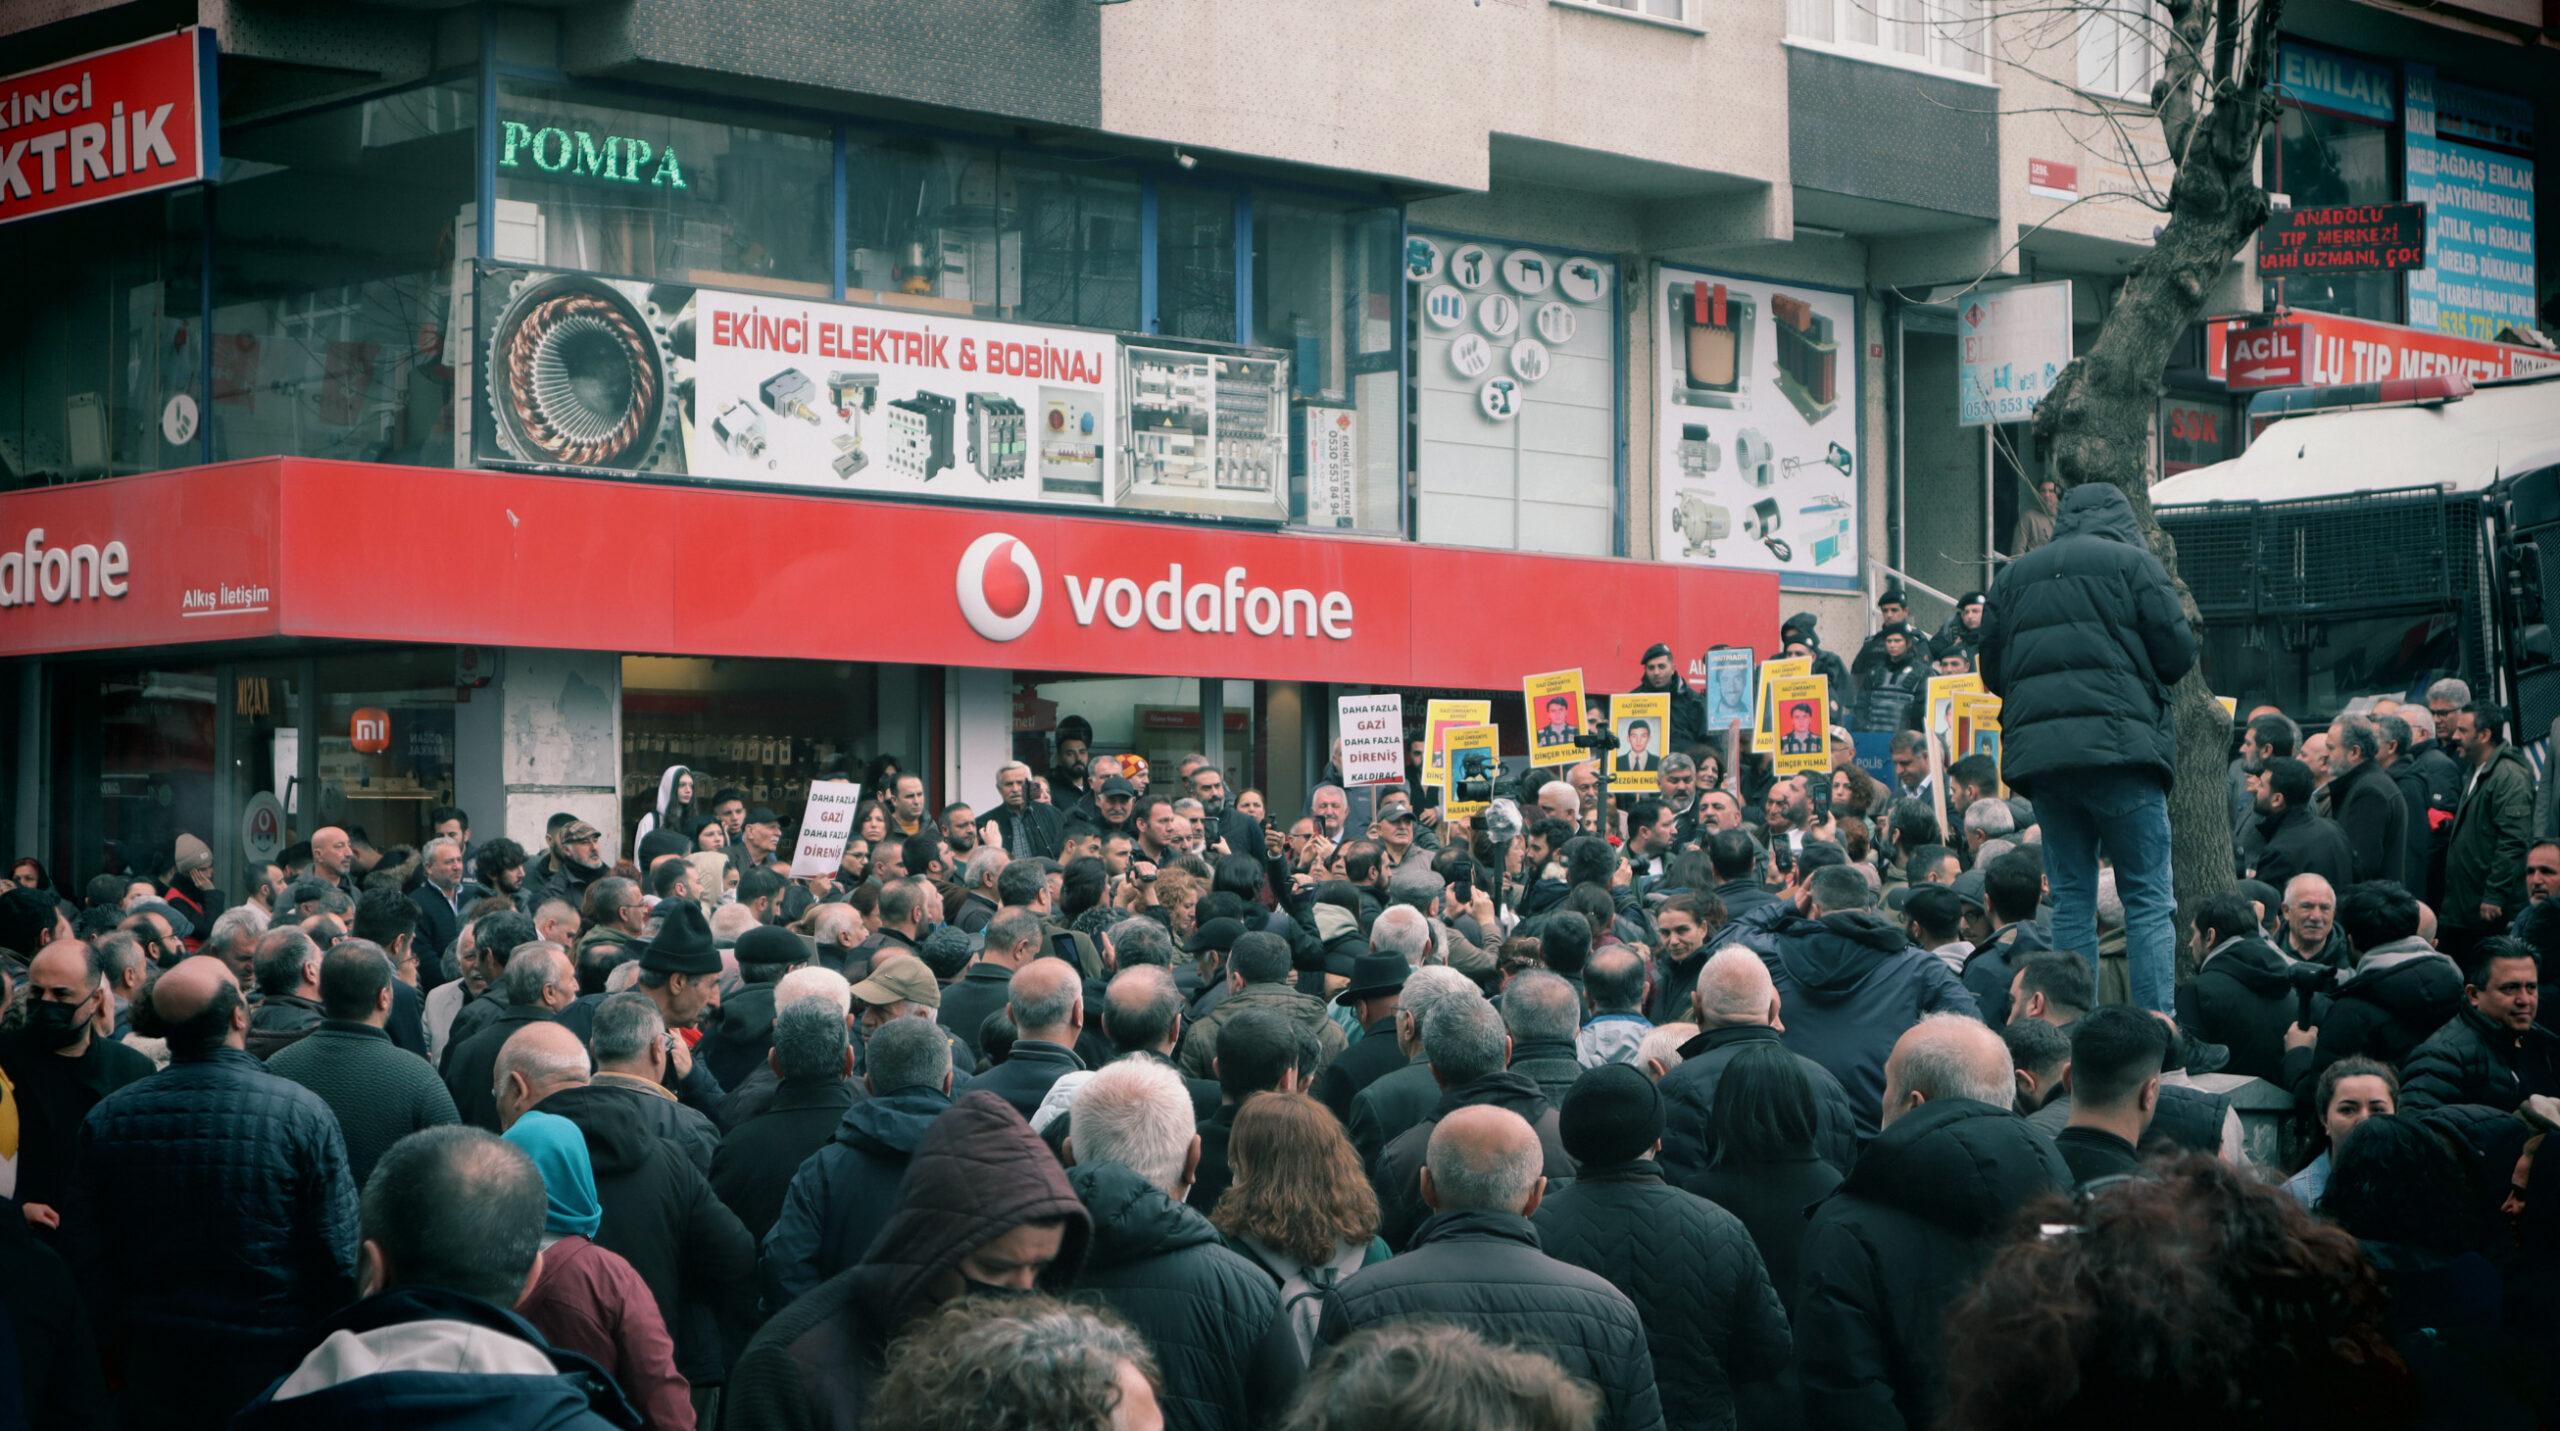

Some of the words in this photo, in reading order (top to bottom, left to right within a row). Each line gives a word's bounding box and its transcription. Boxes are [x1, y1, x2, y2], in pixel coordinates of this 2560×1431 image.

[2284, 50, 2392, 109] EMLAK
[500, 120, 688, 189] POMPA
[2488, 163, 2534, 192] EMLAK
[2436, 182, 2532, 221] GAYRİMENKUL
[2294, 208, 2384, 226] ANADOLU
[2317, 222, 2399, 244] MERKEZİ
[2474, 227, 2487, 245] ve
[2488, 222, 2532, 254] KİRALIK
[2480, 252, 2534, 286] DÜKKANLAR
[713, 306, 809, 355] EKİNCİ
[818, 321, 951, 369] ELEKTRİK
[958, 337, 978, 372] &
[986, 338, 1102, 385] BOBİNAJ
[2233, 331, 2297, 362] ACİL
[2351, 340, 2393, 383] TIP
[2000, 397, 2023, 414] 553
[2171, 408, 2218, 443] SSK
[1329, 430, 1338, 459] 0530
[1329, 464, 1339, 483] 553
[1330, 486, 1339, 499] 84
[1330, 502, 1340, 516] 94
[182, 588, 217, 611] Alkış
[220, 582, 269, 607] İletişim
[1063, 563, 1353, 640] vodafone
[1342, 706, 1368, 715] DAHA
[1371, 704, 1398, 713] FAZLA
[1357, 717, 1386, 731] GAZİ
[1344, 737, 1370, 746] DAHA
[1372, 736, 1400, 745] FAZLA
[1350, 752, 1398, 764] DİRENİŞ
[1535, 749, 1561, 761] DİNÇER
[1777, 760, 1801, 768] DİNÇER
[1803, 758, 1827, 767] YILMAZ
[1856, 755, 1884, 769] POLİS
[1351, 771, 1397, 781] KALDIRAÇ
[811, 793, 834, 803] DAHA
[836, 795, 856, 805] FAZLA
[820, 810, 844, 823] GAZİ
[803, 828, 827, 838] DAHA
[829, 831, 848, 840] FAZLA
[803, 844, 842, 861] DİRENİŞ
